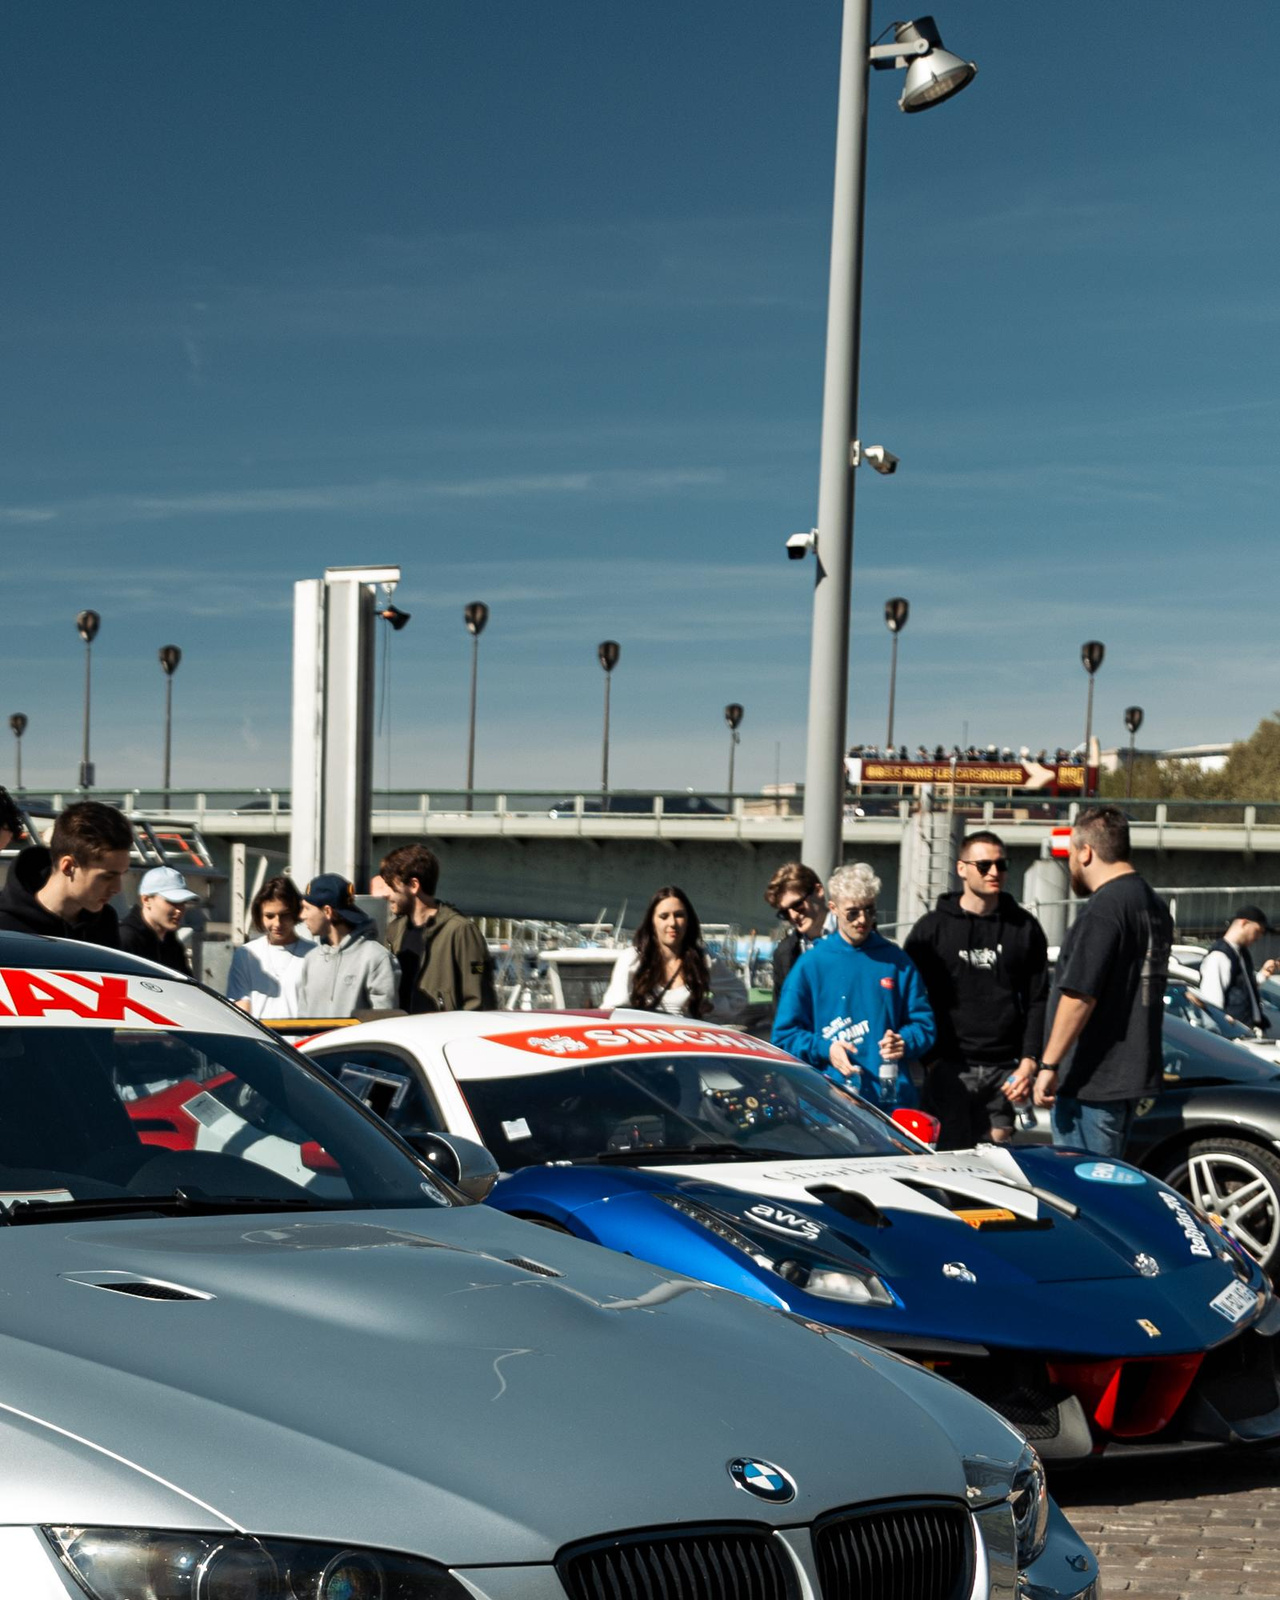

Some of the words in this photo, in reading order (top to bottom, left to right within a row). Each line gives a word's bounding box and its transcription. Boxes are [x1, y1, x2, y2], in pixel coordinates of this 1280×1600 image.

[902, 766, 934, 780] PARIS
[583, 1027, 768, 1052] SINGHA
[750, 1203, 823, 1235] aws
